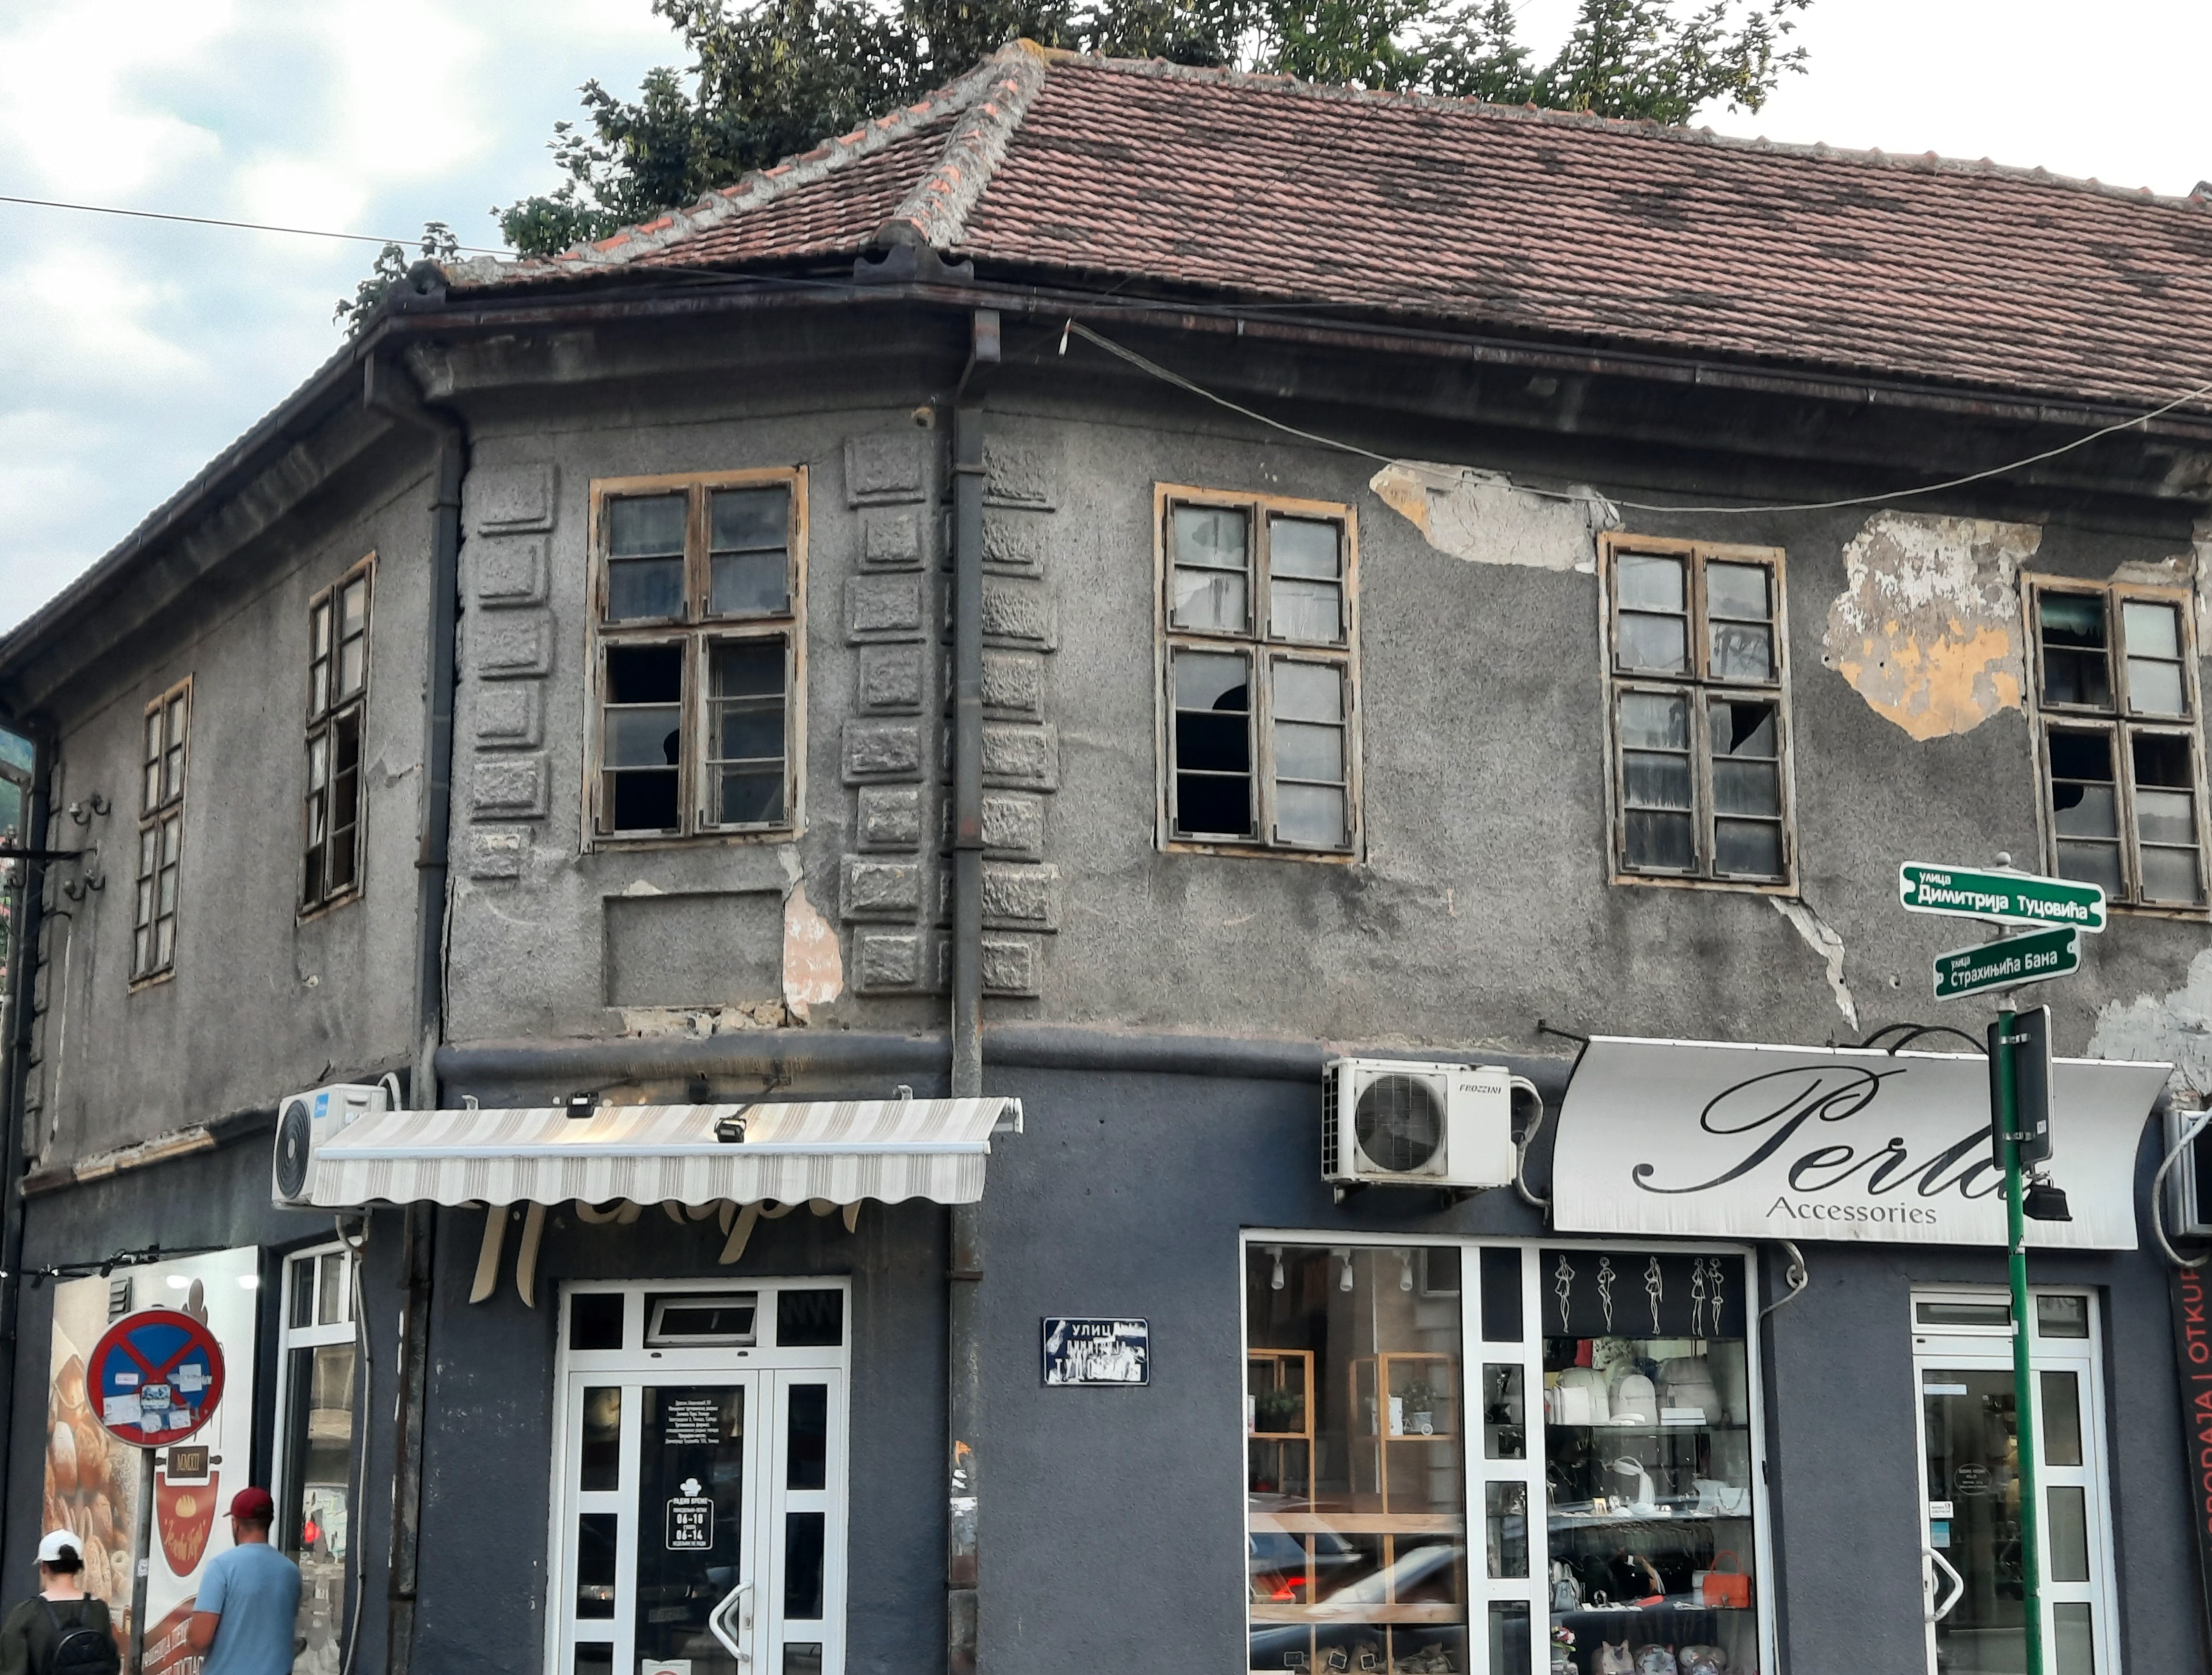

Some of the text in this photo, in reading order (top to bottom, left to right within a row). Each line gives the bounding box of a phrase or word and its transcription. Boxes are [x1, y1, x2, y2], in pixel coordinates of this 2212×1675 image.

[1919, 871, 1951, 886] улица
[1917, 884, 2088, 920] Димитрија Туцовића
[1951, 950, 2058, 987] Страхињића Бана
[1459, 1084, 1501, 1094] FROZZINI
[1765, 1196, 1938, 1225] Accessories
[2180, 1267, 2210, 1364] OTKUP
[1072, 1324, 1120, 1337] УЛИЦ
